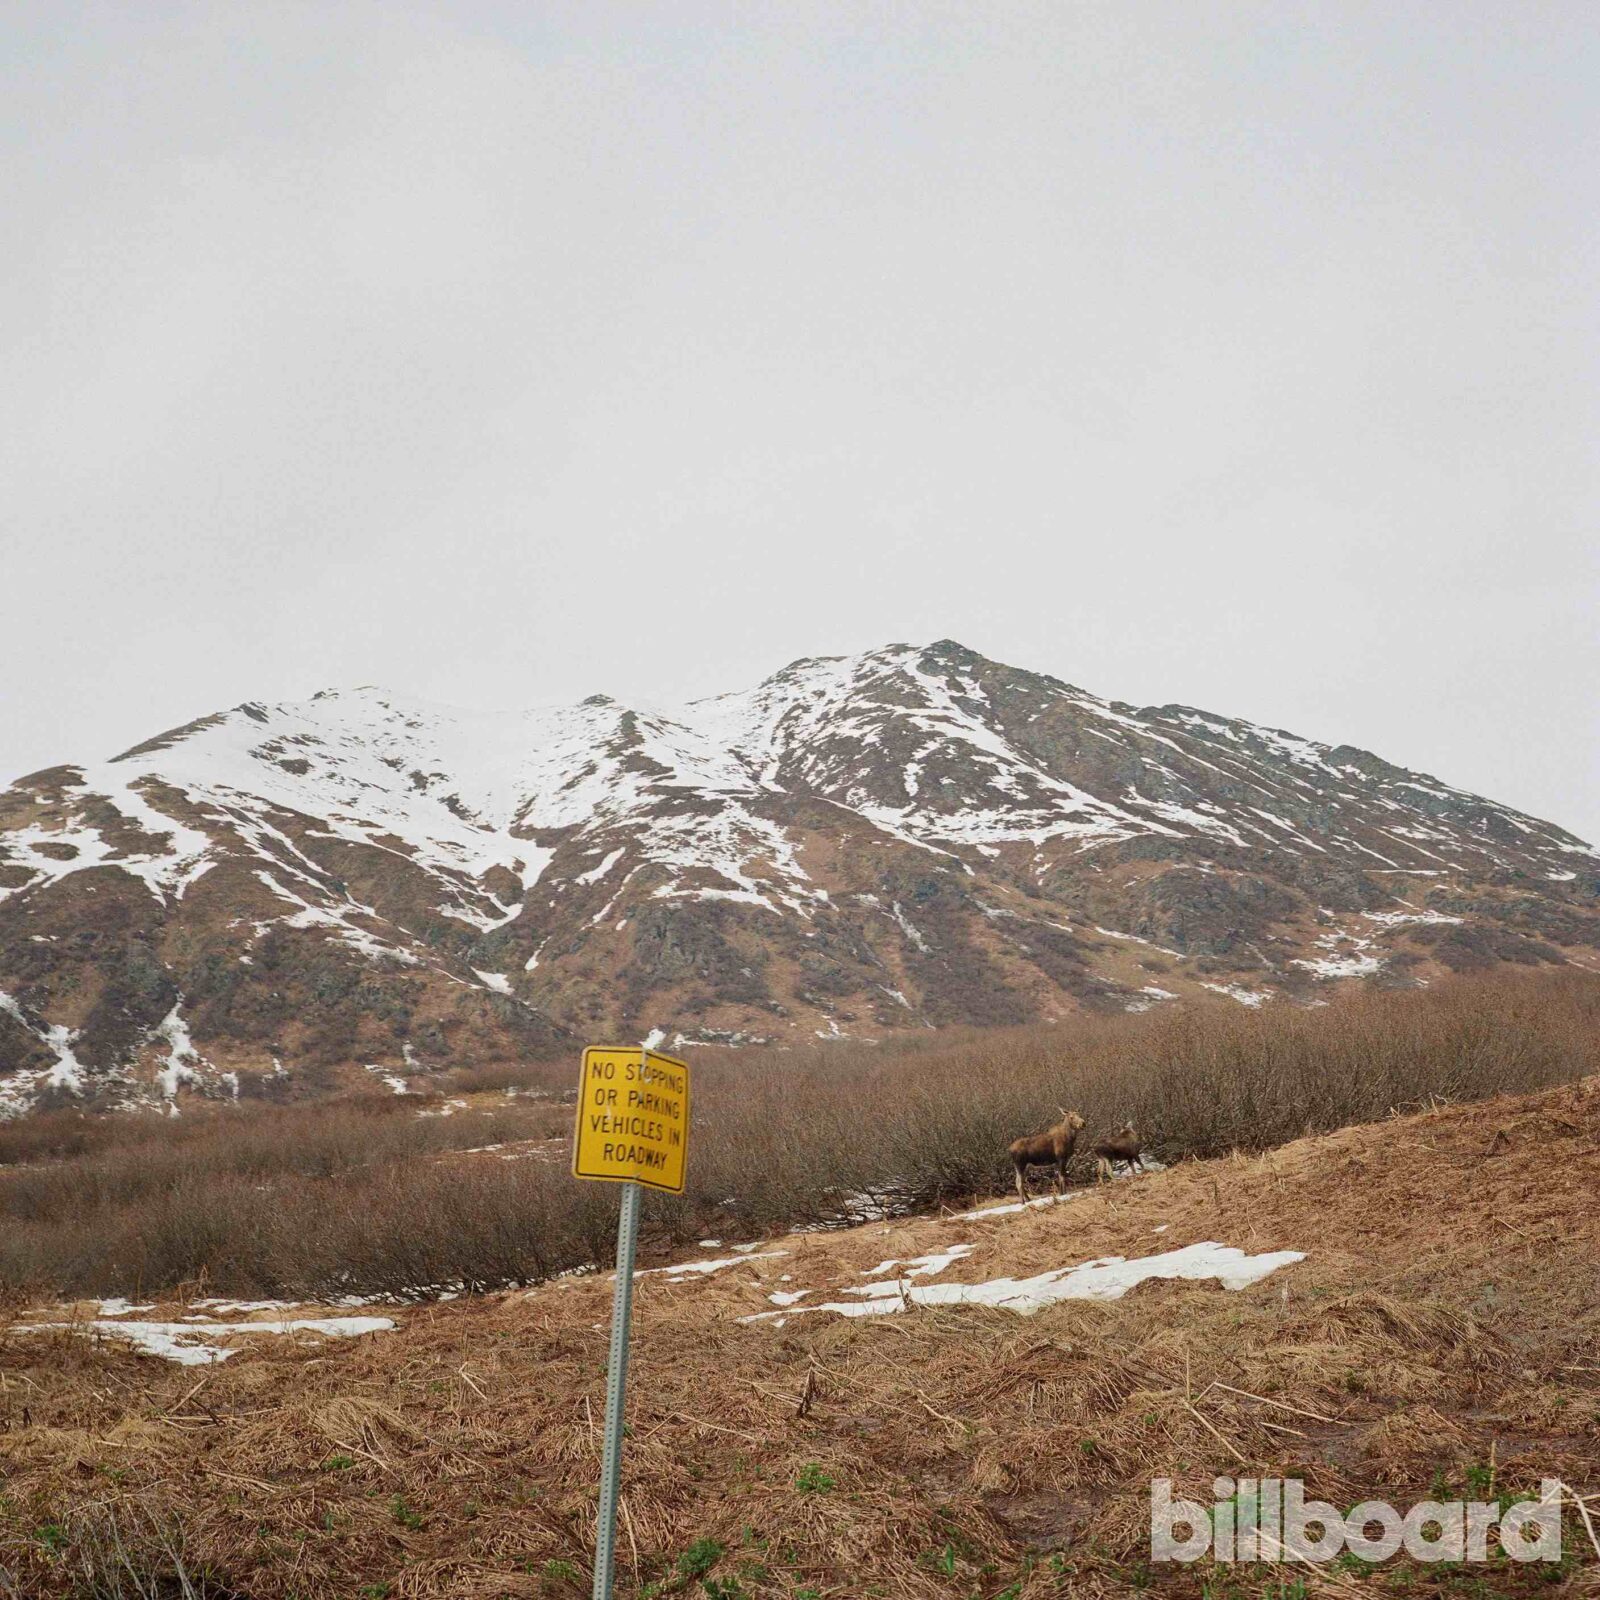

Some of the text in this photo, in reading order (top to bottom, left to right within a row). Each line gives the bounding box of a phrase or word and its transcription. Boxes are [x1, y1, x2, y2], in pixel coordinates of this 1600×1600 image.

[592, 1062, 683, 1094] NO STOPPING
[595, 1088, 680, 1119] OR PARKING
[591, 1115, 681, 1146] VEHICLES IN
[603, 1143, 667, 1171] ROADWAY
